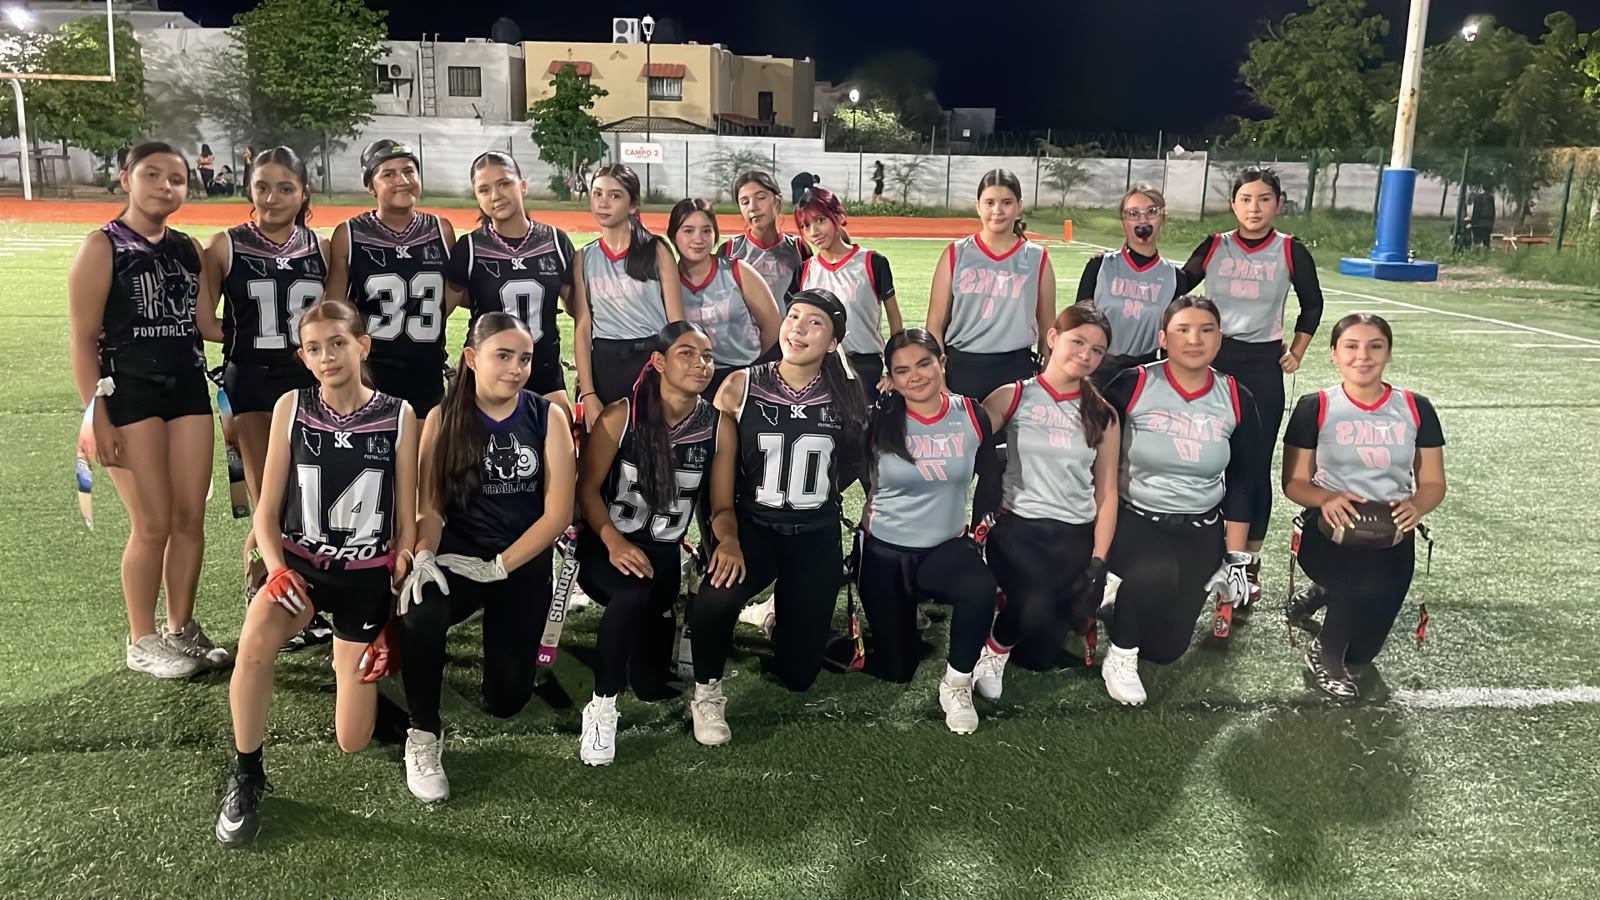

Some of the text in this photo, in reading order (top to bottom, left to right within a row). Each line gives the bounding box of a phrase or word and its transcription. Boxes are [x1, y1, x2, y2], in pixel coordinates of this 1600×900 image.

[624, 149, 652, 157] CAMPO
[364, 271, 444, 342] 33
[297, 464, 385, 547] 14
[608, 460, 704, 543] 55
[755, 433, 836, 510] 10
